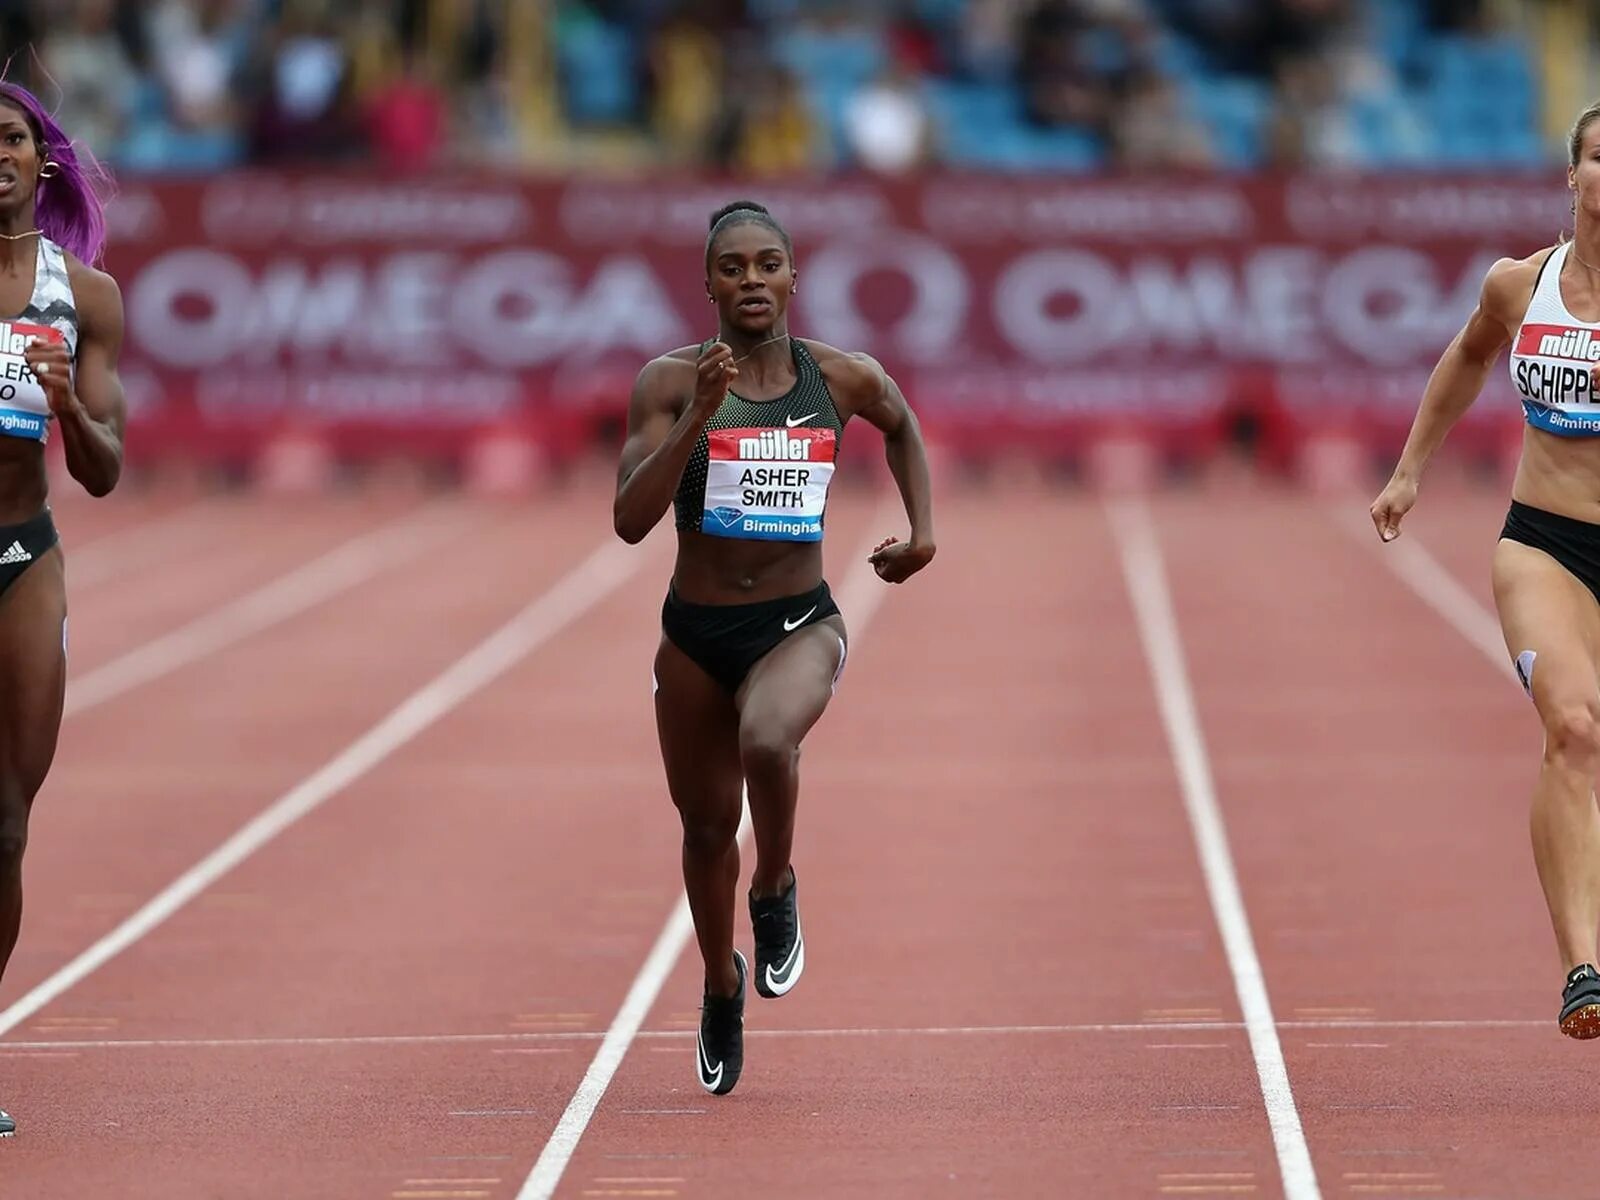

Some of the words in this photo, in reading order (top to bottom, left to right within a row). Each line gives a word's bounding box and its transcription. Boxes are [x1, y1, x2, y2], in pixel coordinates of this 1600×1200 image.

[128, 248, 688, 368] OMEGA
[739, 430, 812, 460] müller
[739, 469, 810, 487] ASHER
[742, 489, 804, 508] SMITH
